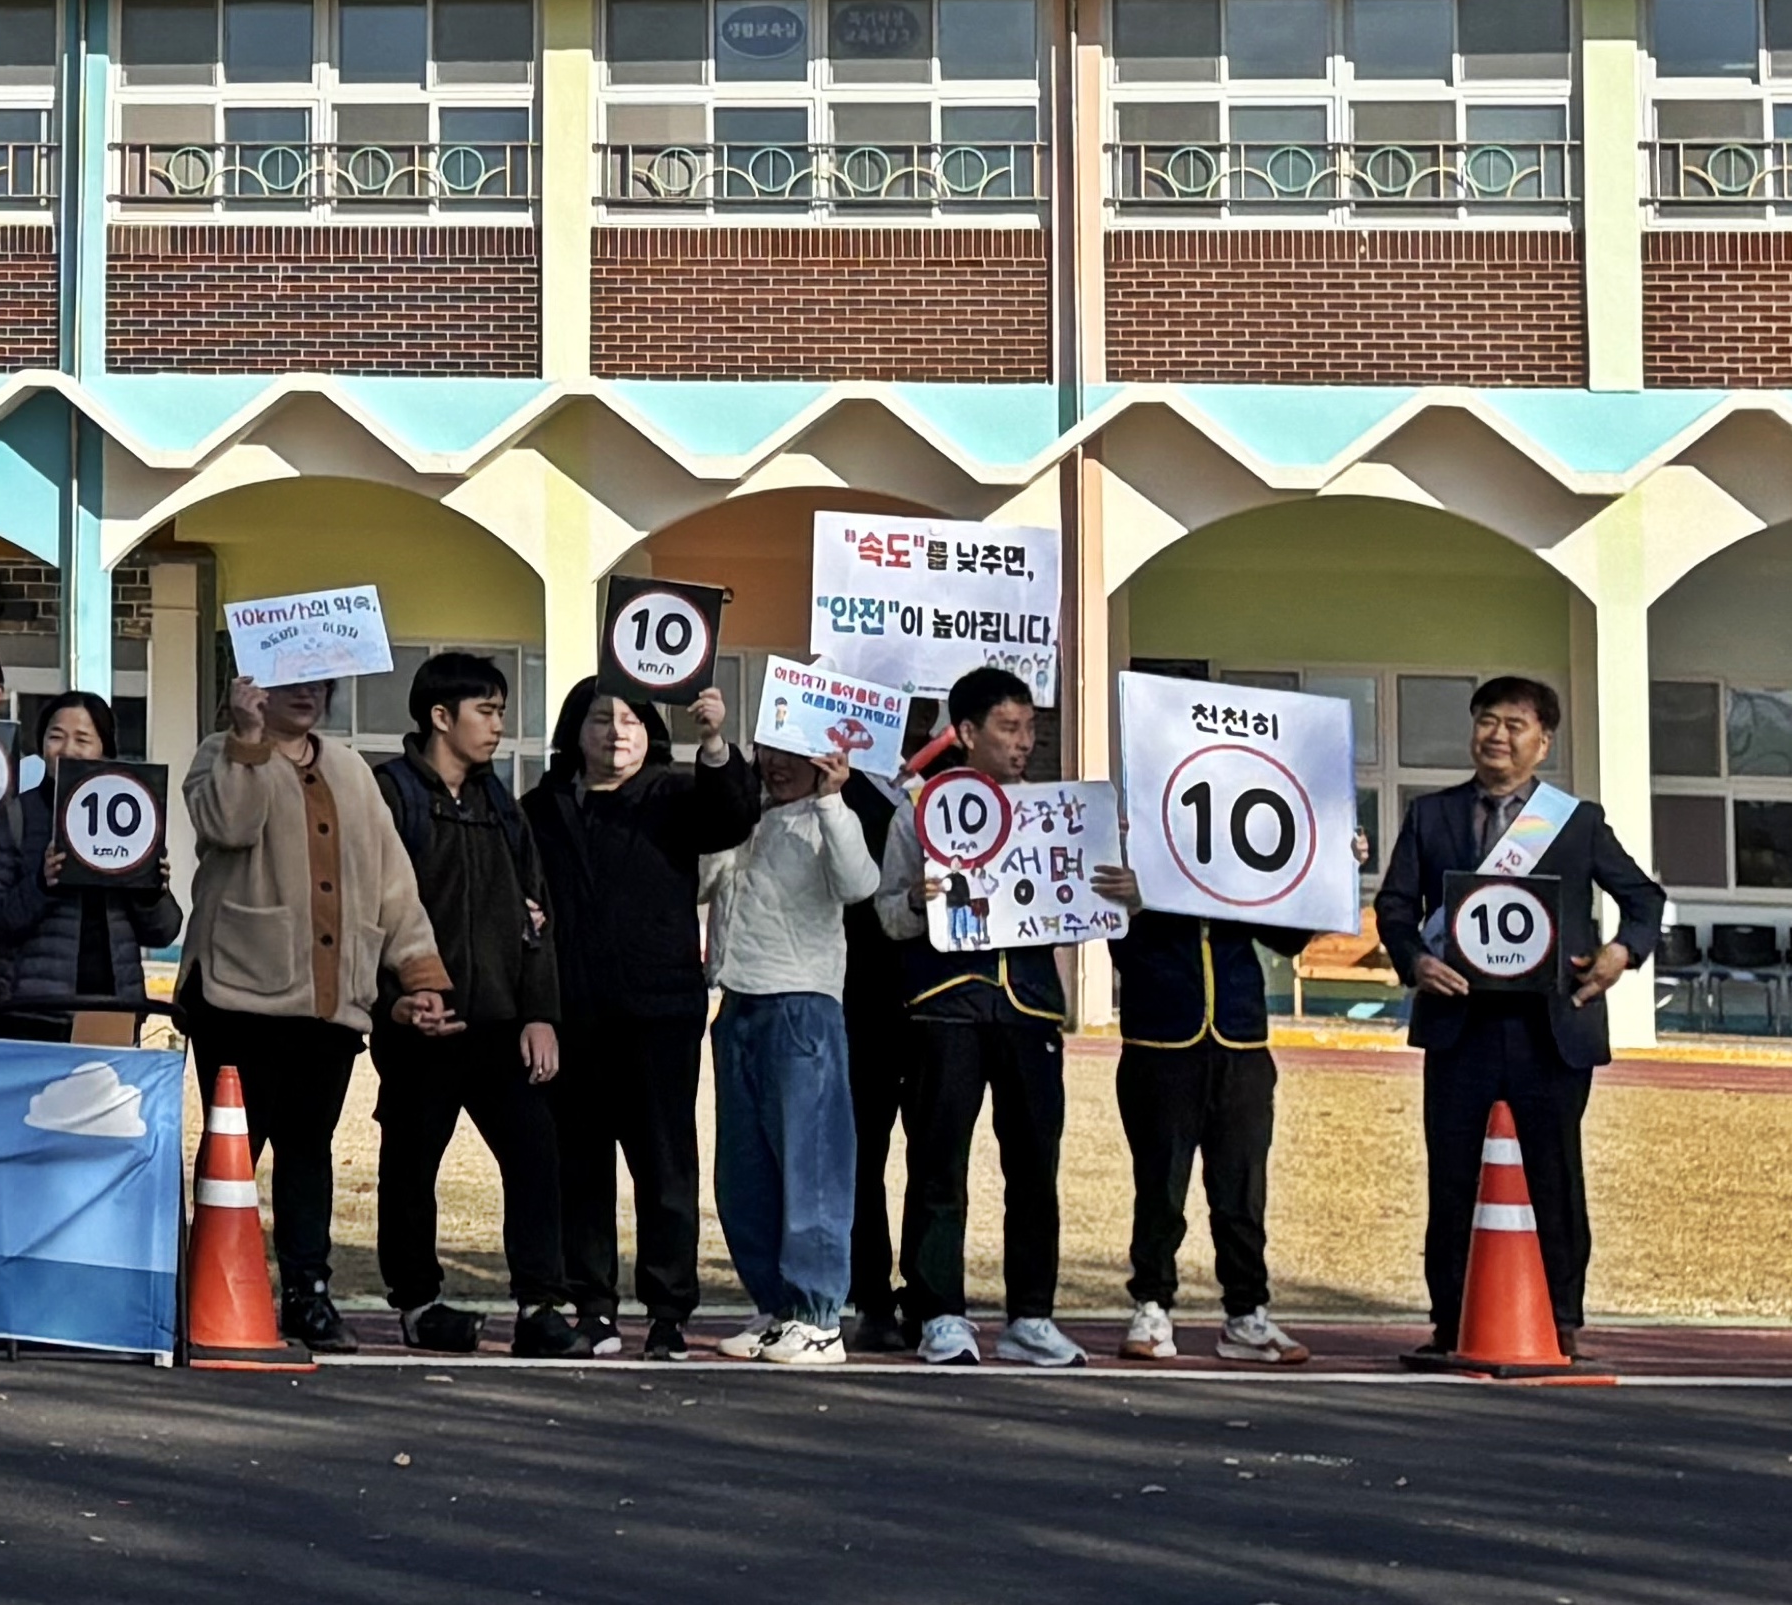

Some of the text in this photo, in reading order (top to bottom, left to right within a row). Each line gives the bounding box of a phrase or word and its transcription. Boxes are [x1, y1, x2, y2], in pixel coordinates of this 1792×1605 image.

[956, 541, 1035, 583] 낮추면,
[631, 608, 693, 656] 10
[638, 658, 675, 676] km/h
[1191, 702, 1280, 742] 천천히
[80, 791, 143, 838] 10
[937, 792, 989, 835] 10
[1180, 780, 1297, 873] 10
[92, 844, 130, 859] km/h
[1000, 845, 1085, 907] 생명
[1470, 902, 1535, 946] 10
[1486, 952, 1526, 966] km/h
